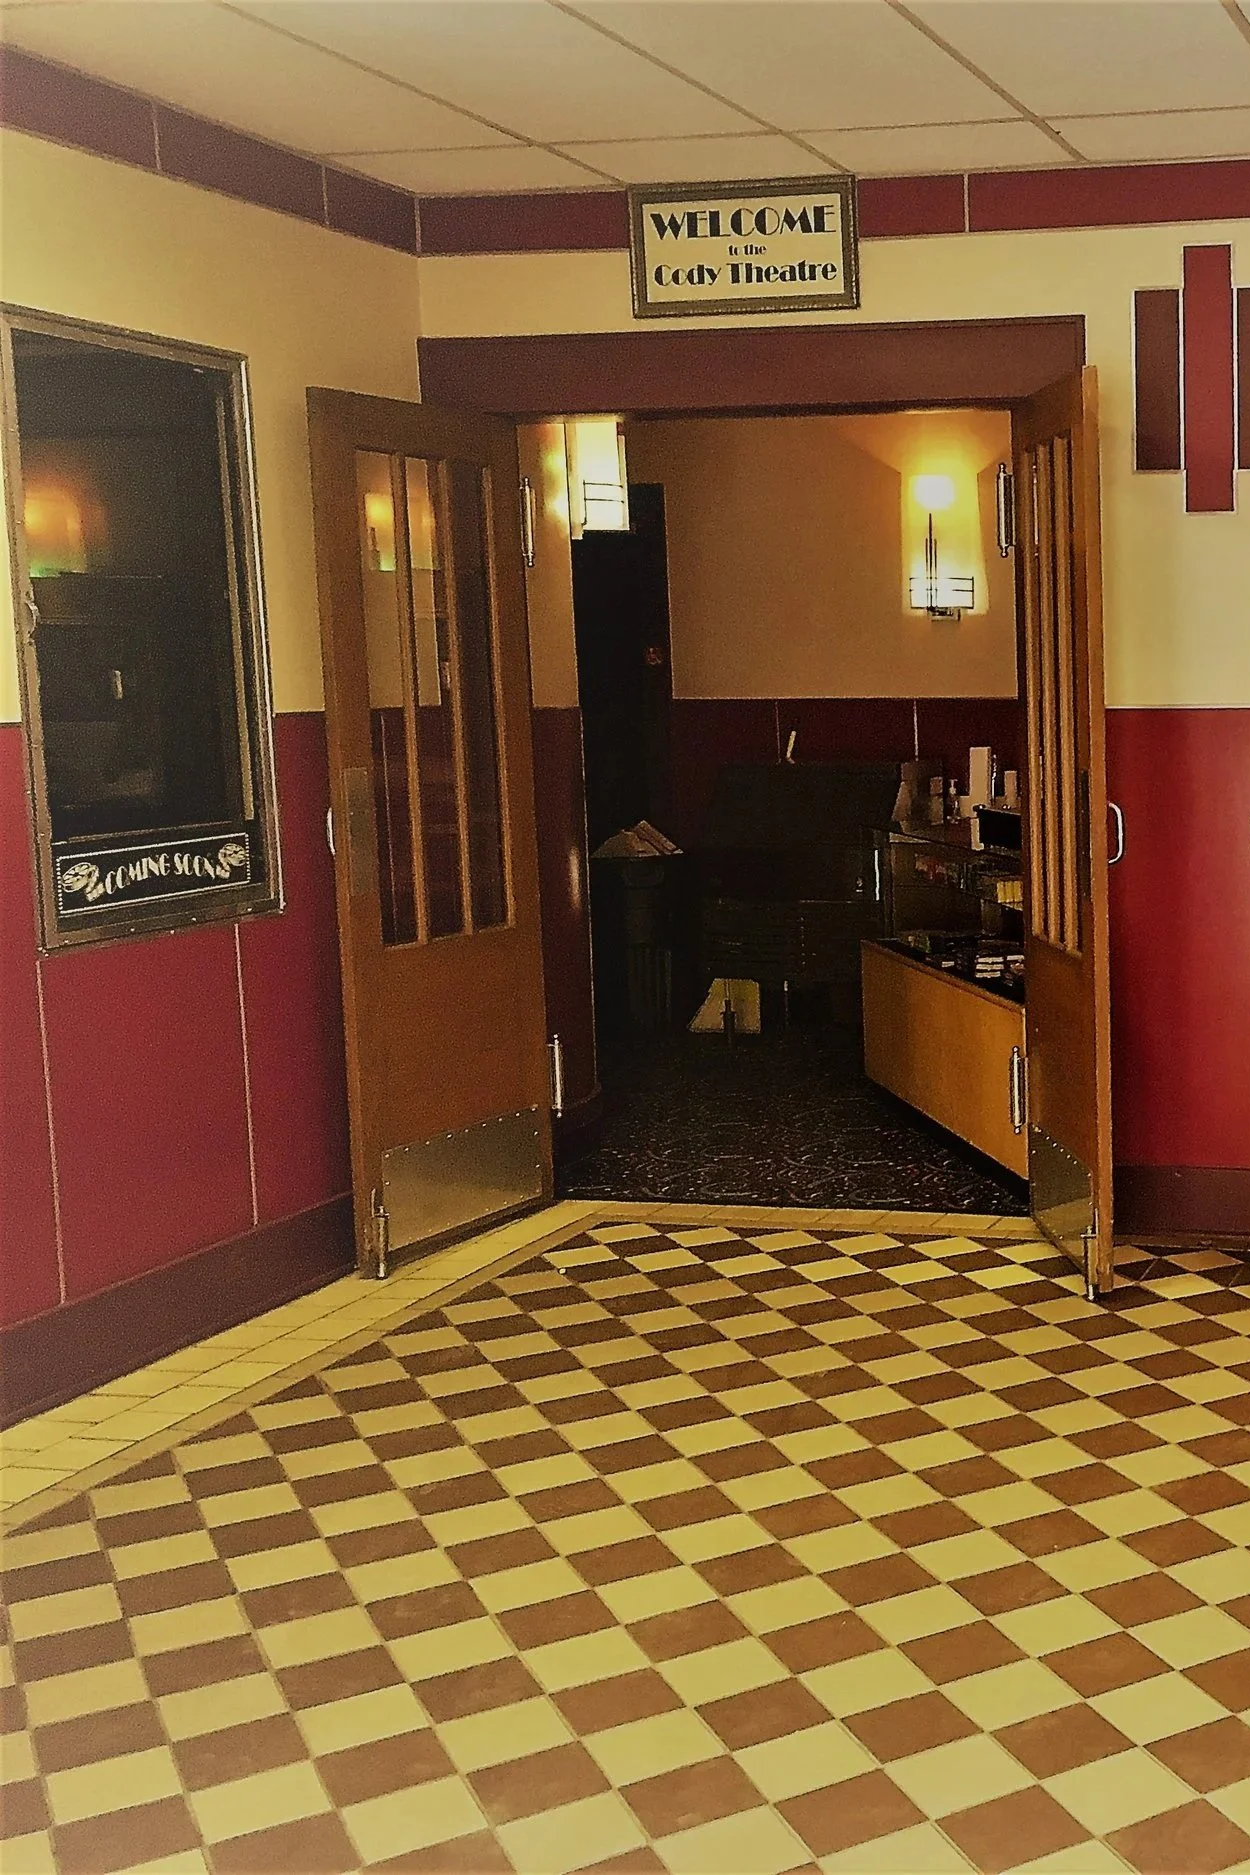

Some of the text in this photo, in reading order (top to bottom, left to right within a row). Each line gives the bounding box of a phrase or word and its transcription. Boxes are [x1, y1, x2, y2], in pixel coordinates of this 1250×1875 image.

[649, 204, 837, 241] WELCOME
[728, 243, 768, 257] to the
[653, 259, 838, 287] Cody Theatre
[104, 852, 216, 895] COMING SOON
